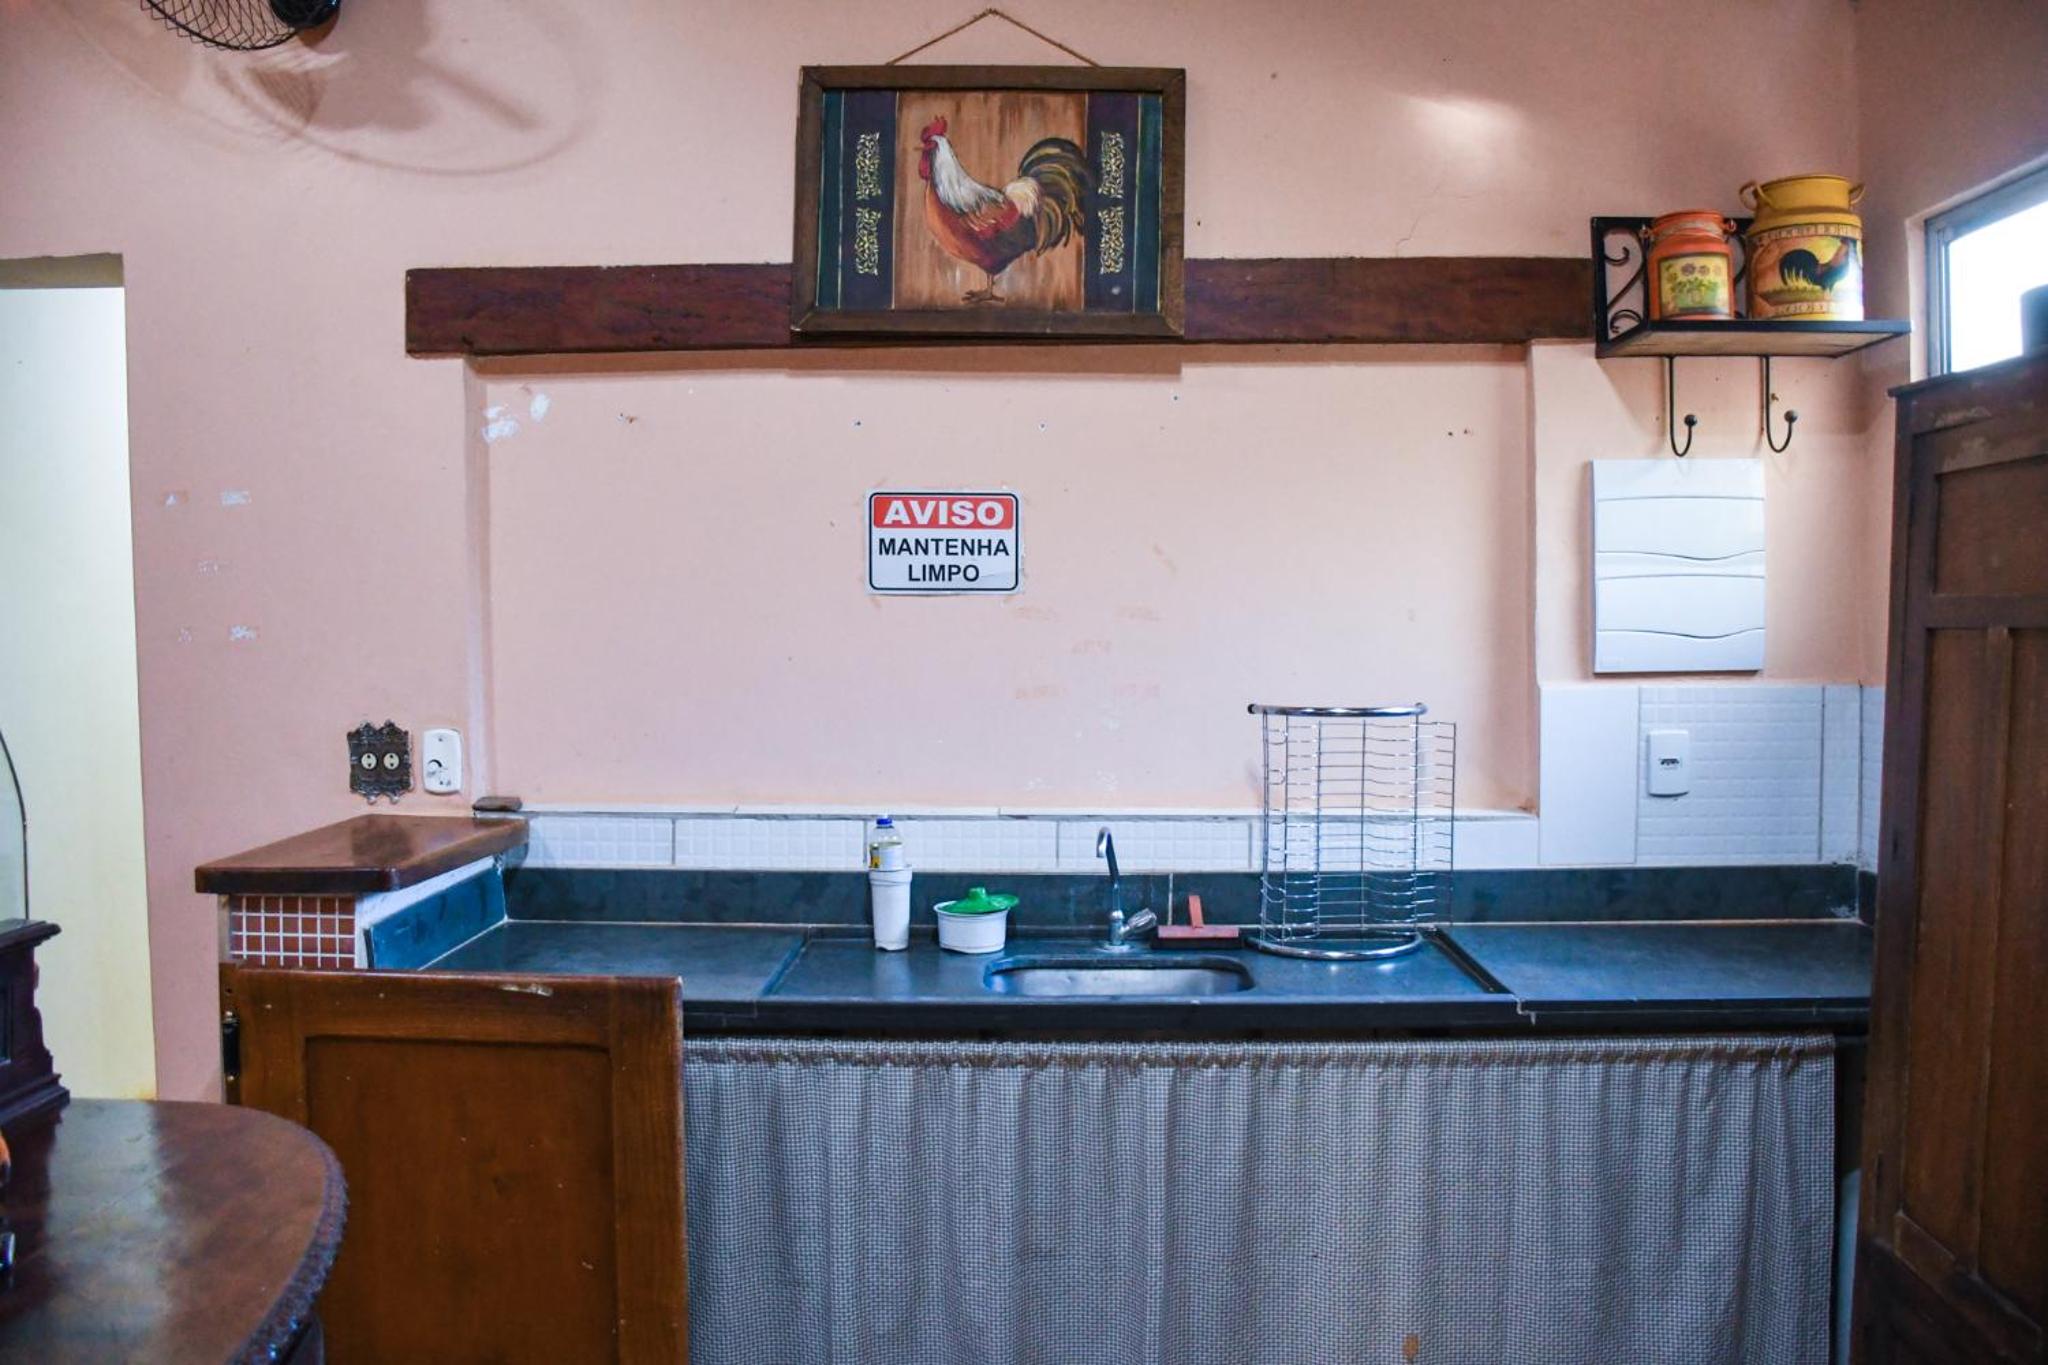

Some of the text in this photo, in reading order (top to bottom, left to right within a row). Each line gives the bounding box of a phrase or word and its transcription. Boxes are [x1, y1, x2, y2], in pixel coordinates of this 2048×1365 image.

[883, 500, 1004, 526] AVISO
[878, 538, 1010, 556] MANTENHA
[908, 564, 980, 582] LIMPO
